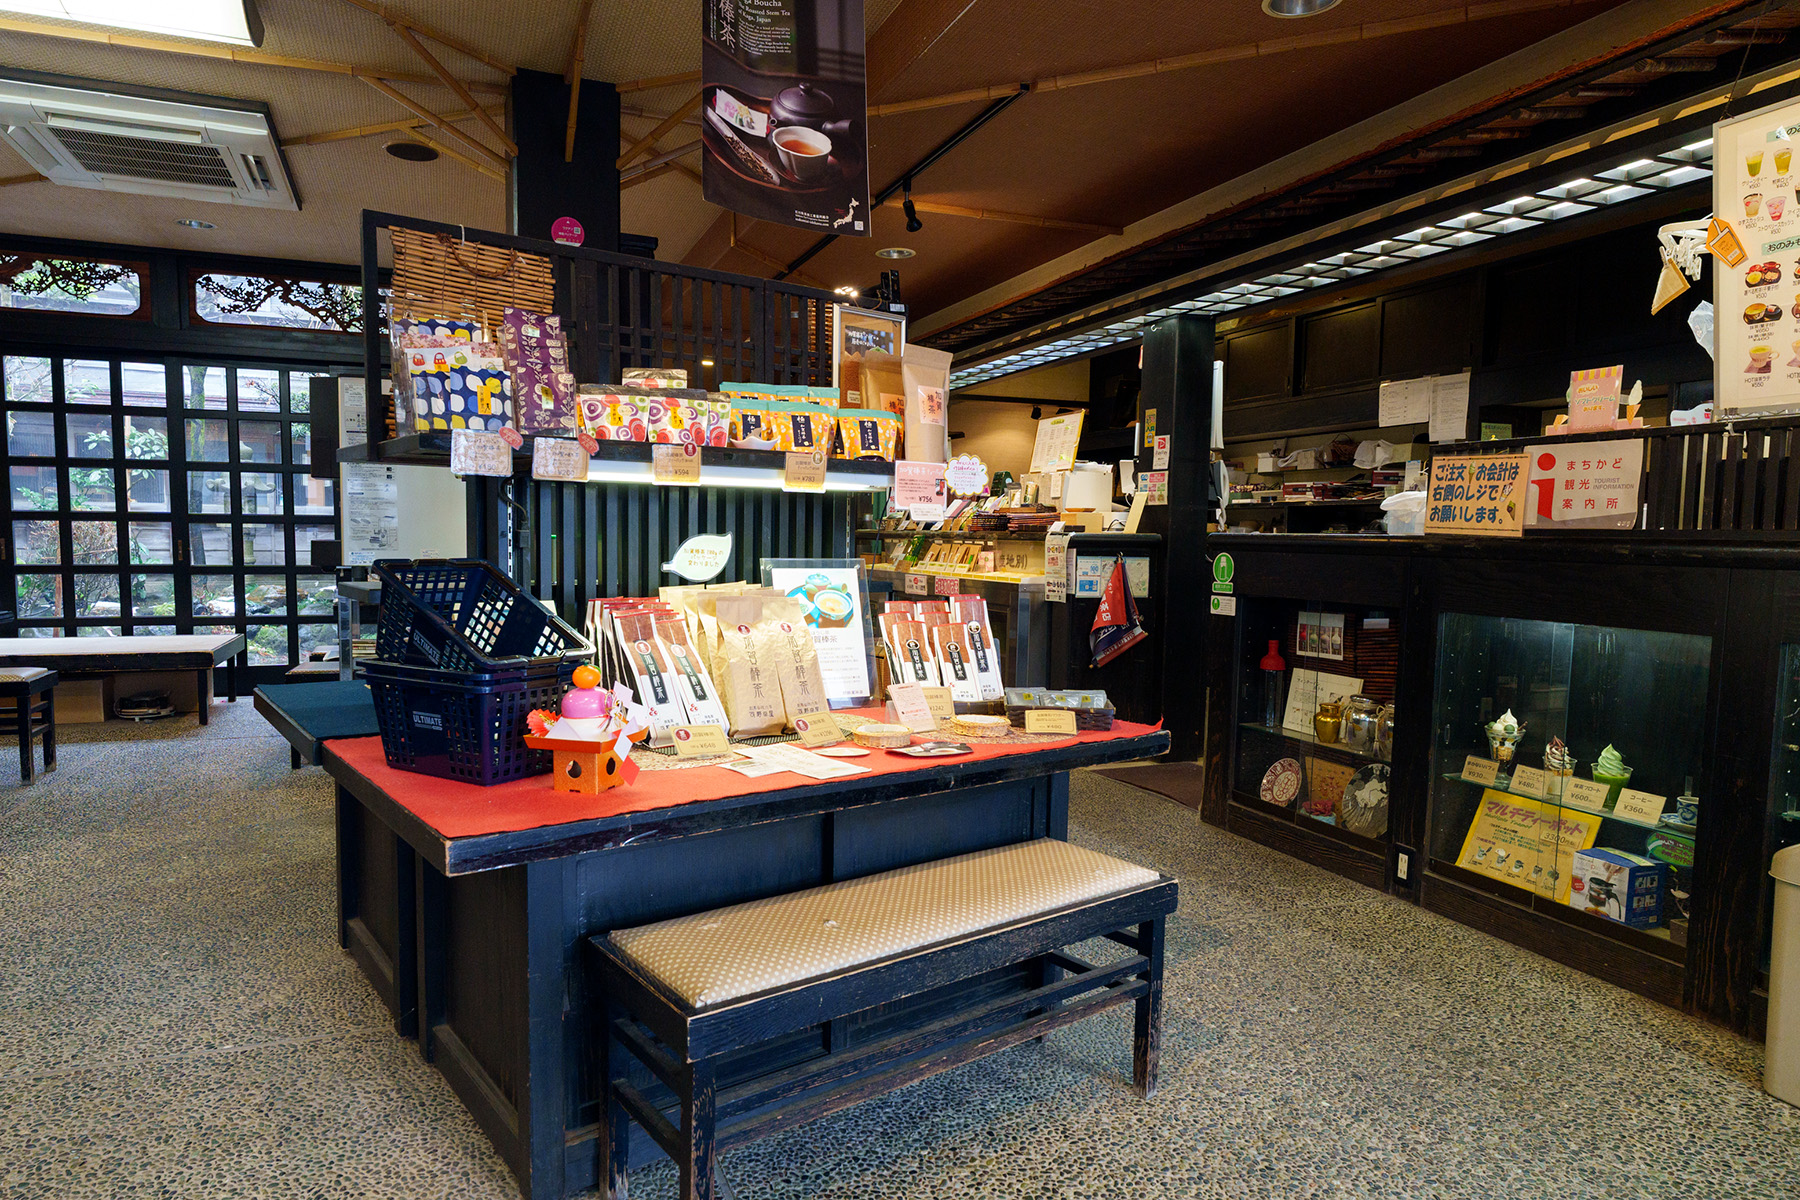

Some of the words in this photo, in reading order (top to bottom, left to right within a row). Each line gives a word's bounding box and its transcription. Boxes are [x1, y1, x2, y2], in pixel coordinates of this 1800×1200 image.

[1578, 384, 1599, 394] おいしい
[1575, 395, 1616, 405] ソフトクリーム
[1566, 457, 1623, 471] まちかど
[1435, 463, 1466, 482] ご注文
[1476, 462, 1520, 482] お会計は
[1564, 478, 1590, 491] 観光
[1432, 484, 1498, 502] 右側のレジで
[1562, 498, 1618, 510] 案内所
[1429, 505, 1503, 524] お願いします。
[812, 635, 837, 644] 賀棒茶
[413, 632, 440, 661] ULTIMATE
[413, 714, 442, 726] ULTIMATE
[1518, 780, 1534, 788] ¥480
[1574, 783, 1601, 793] 抹茶フロート
[1570, 793, 1589, 802] ¥600
[1630, 794, 1653, 803] コーヒー
[1623, 804, 1644, 814] ¥360
[1487, 801, 1583, 835] マルチティーポット
